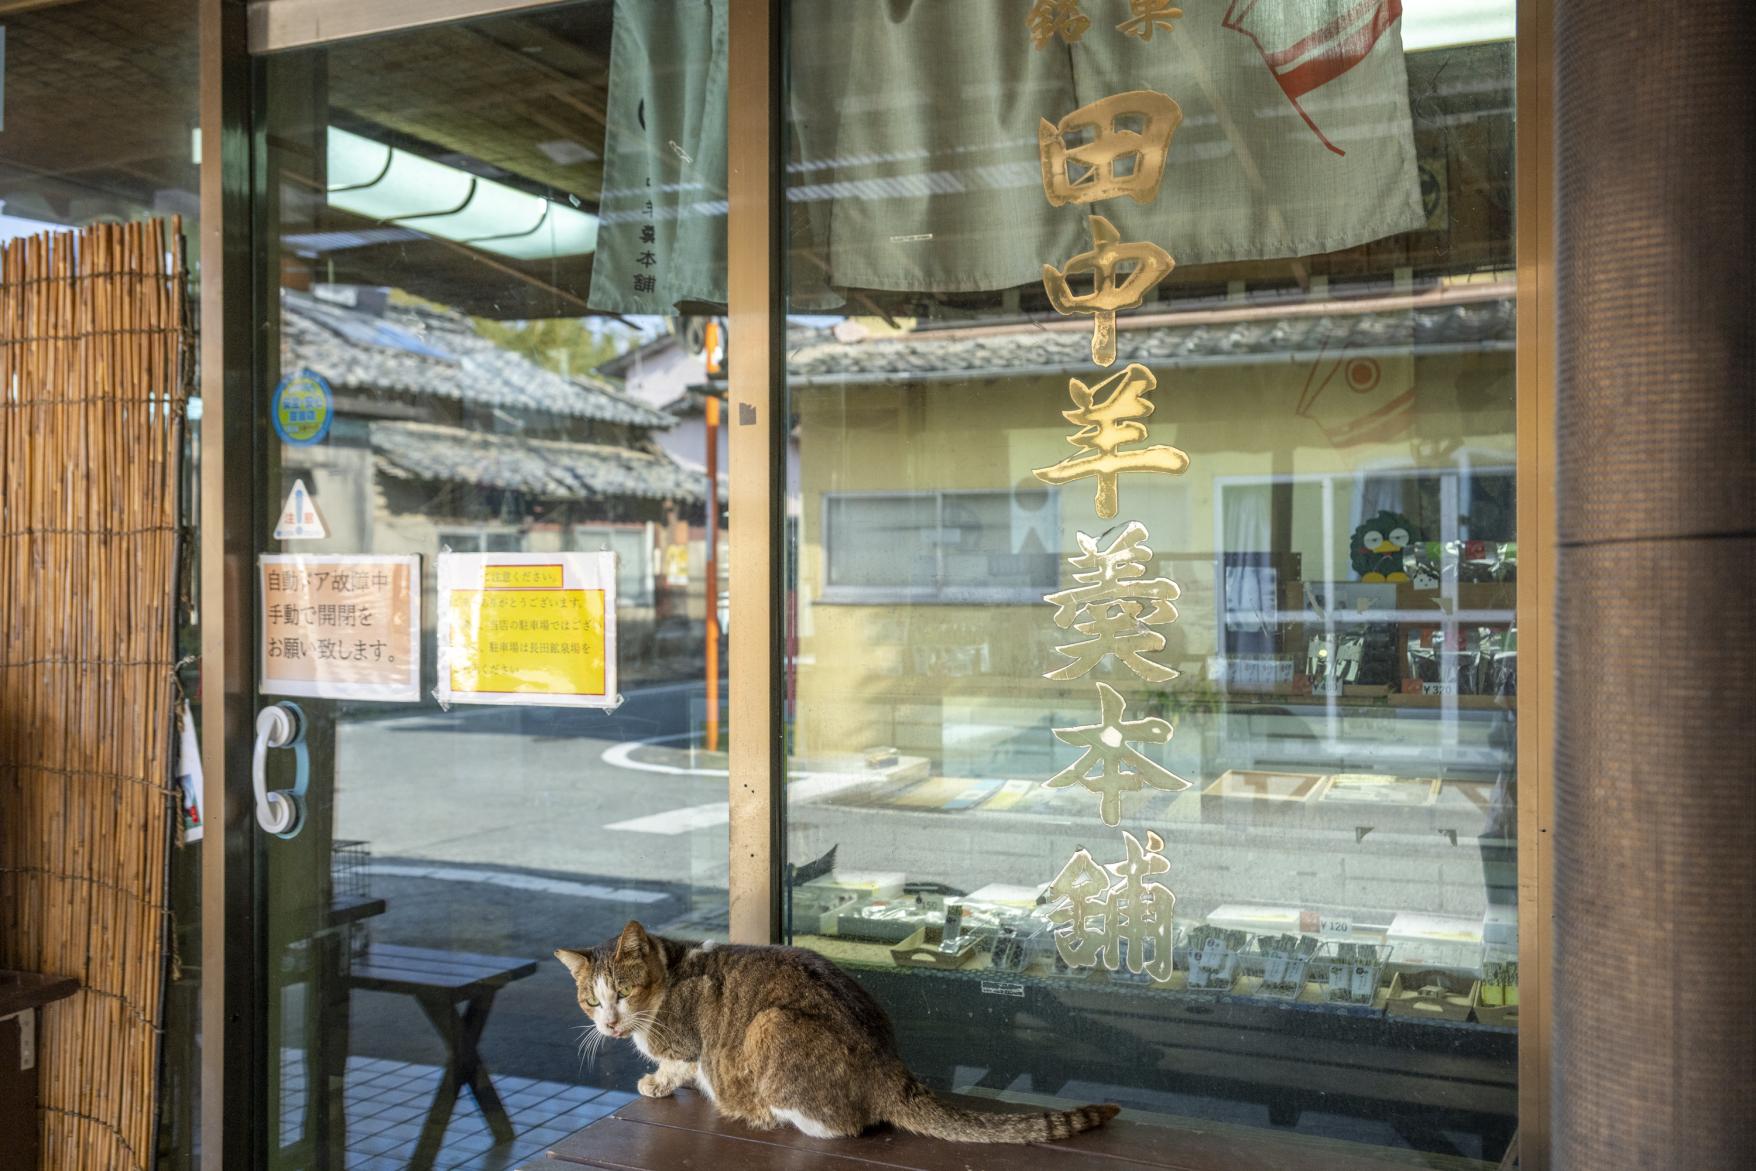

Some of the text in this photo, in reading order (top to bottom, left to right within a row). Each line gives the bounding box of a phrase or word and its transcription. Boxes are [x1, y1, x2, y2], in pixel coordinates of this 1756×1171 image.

[453, 596, 583, 609] ありがとうございます。
[267, 604, 373, 628] 手動で開閉を
[268, 637, 396, 663] お願い致します。
